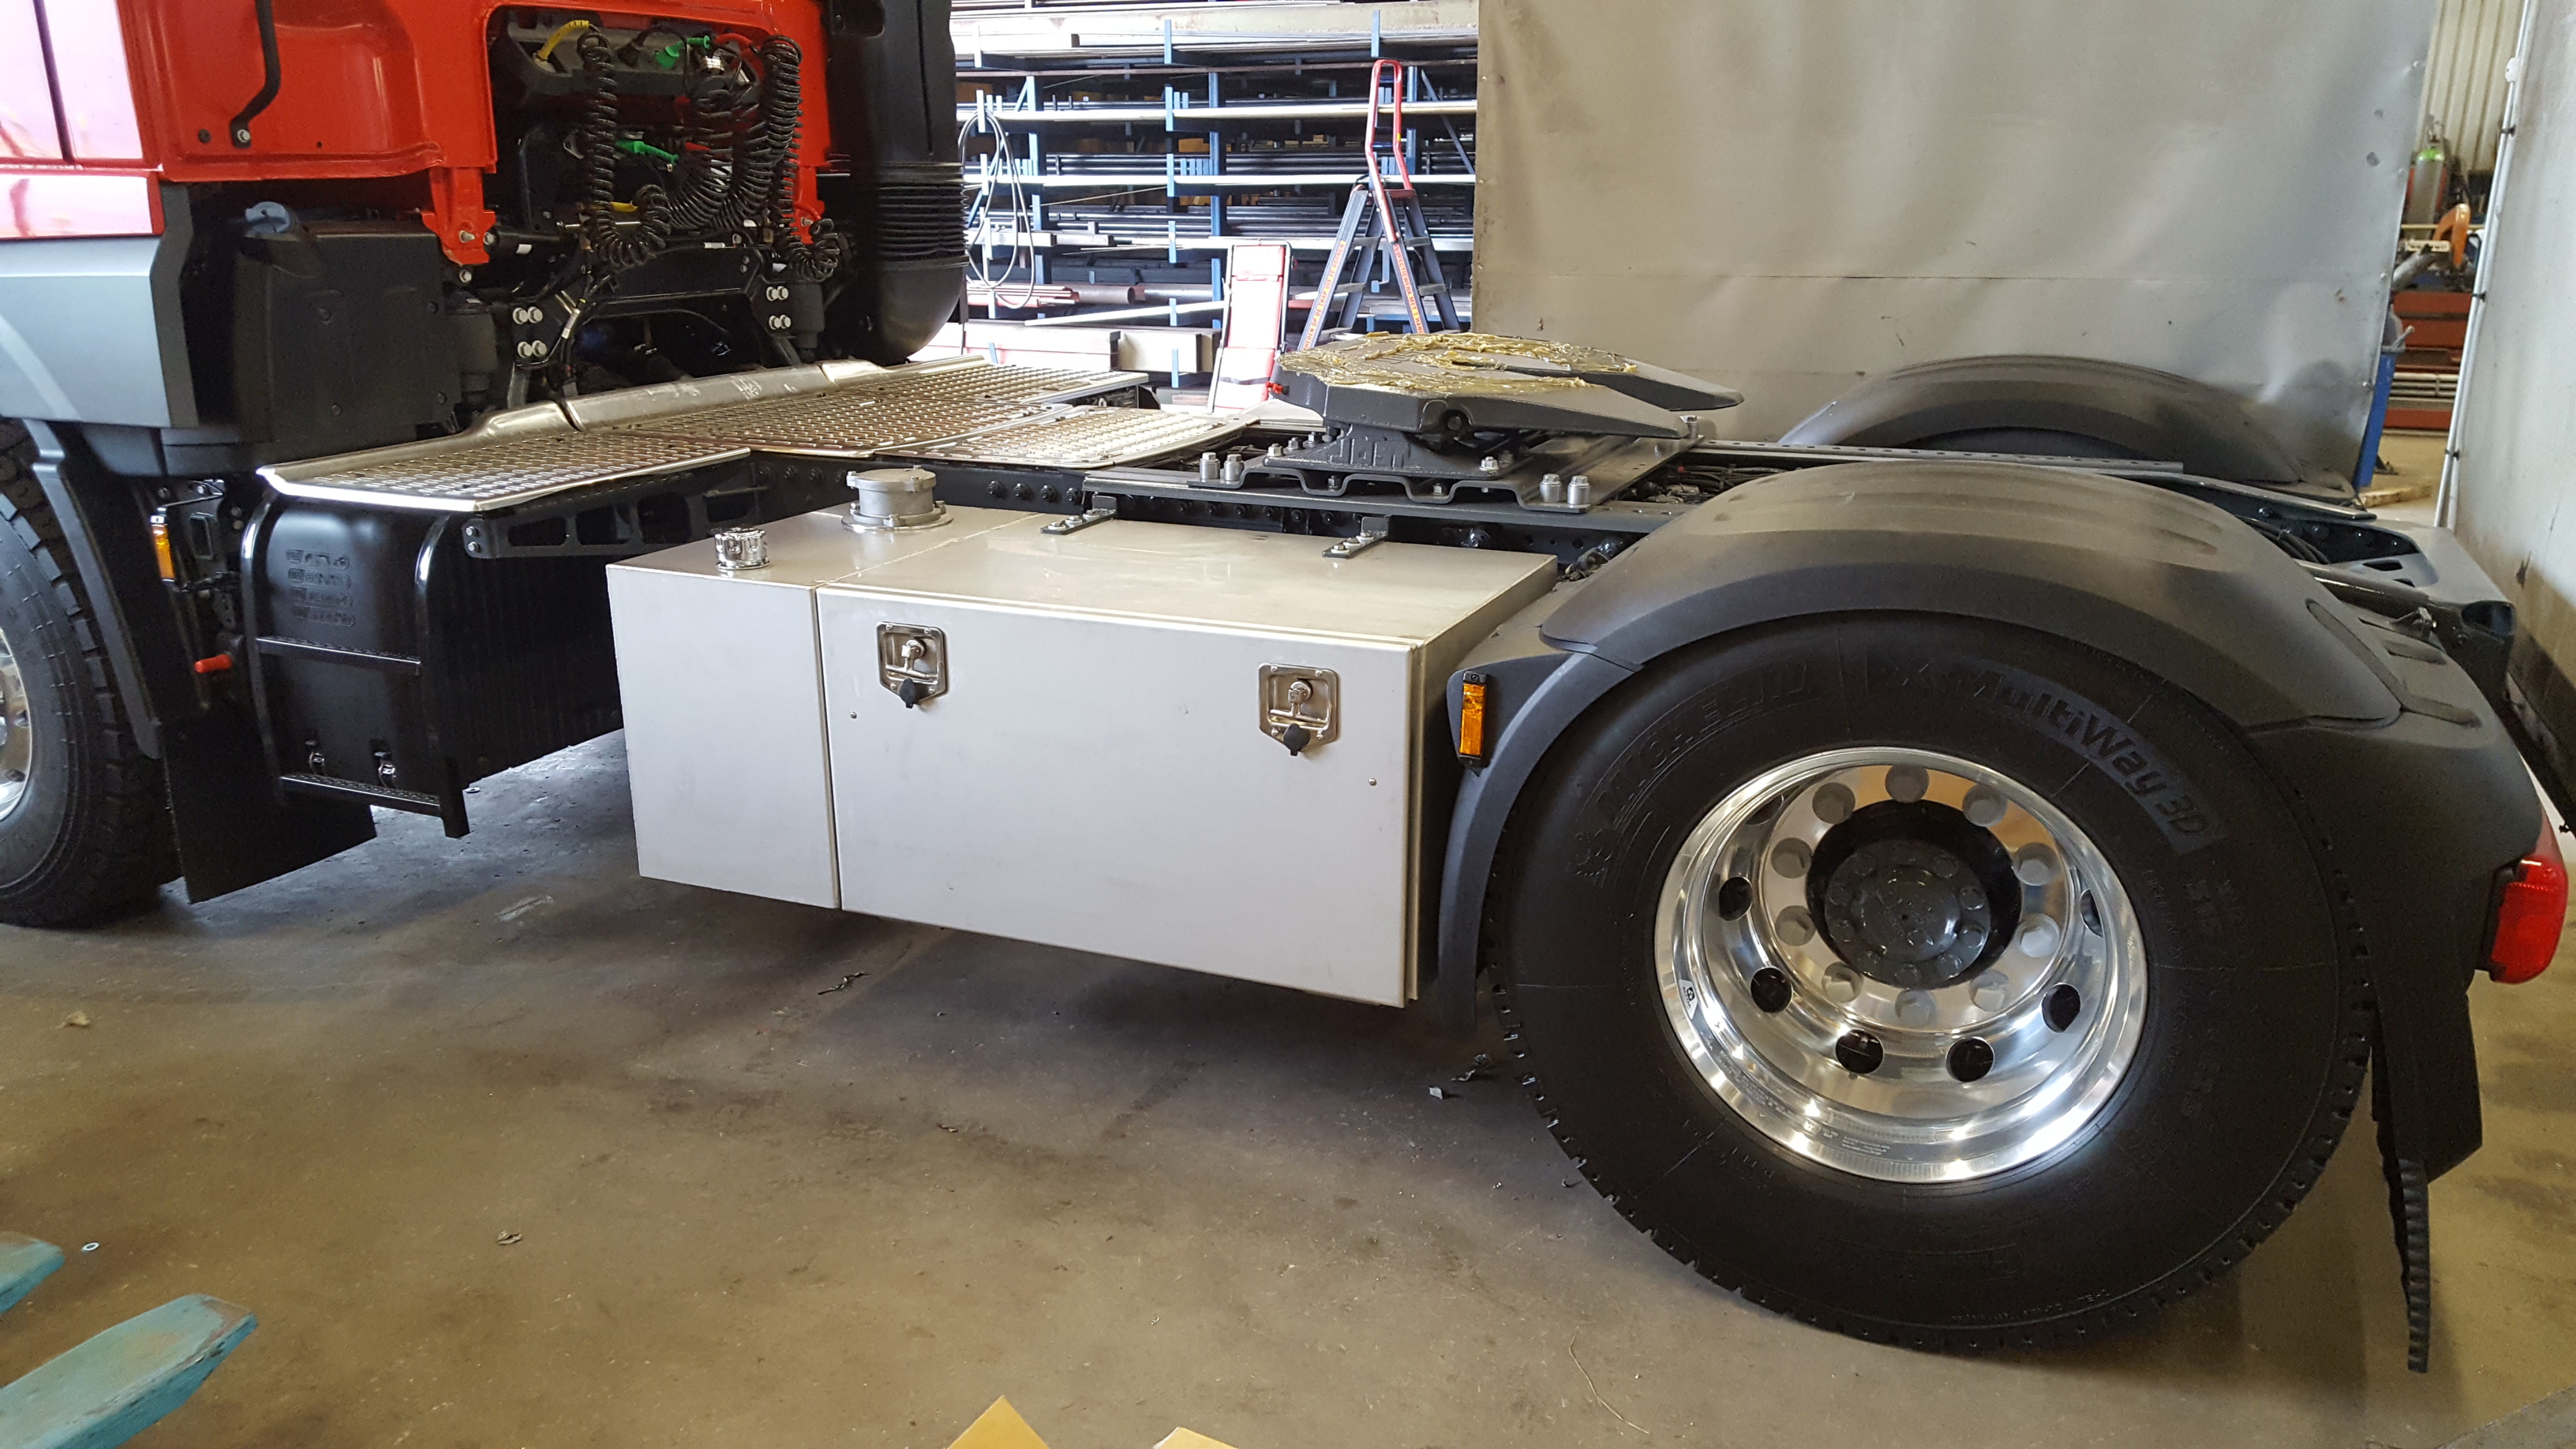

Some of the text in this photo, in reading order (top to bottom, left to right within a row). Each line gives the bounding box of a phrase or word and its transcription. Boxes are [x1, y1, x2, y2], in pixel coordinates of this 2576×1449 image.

[1408, 296, 1417, 309] MET
[1312, 318, 1318, 327] OP
[1315, 309, 1321, 317] DE
[2155, 793, 2211, 837] 3D
